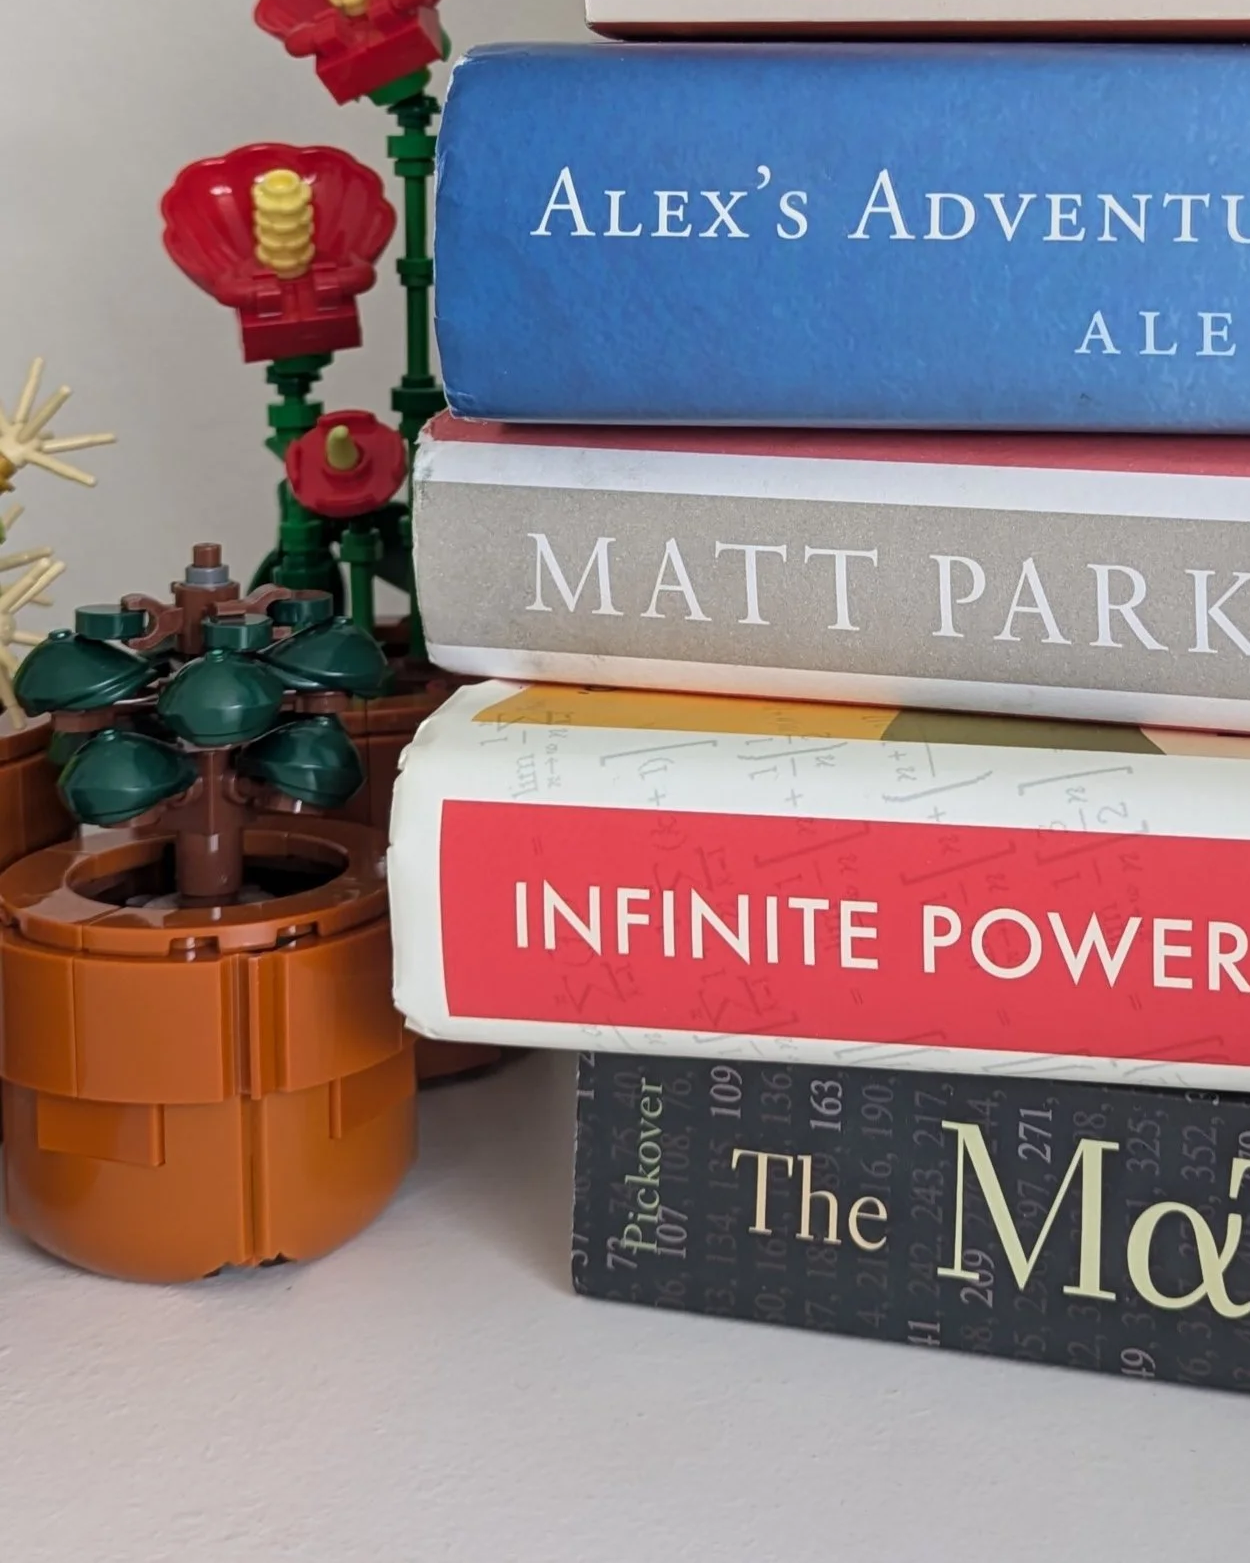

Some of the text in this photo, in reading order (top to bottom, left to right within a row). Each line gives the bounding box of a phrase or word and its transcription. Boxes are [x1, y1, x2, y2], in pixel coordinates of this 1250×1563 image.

[525, 531, 878, 632] MATT
[515, 880, 879, 970] INFINITE
[624, 1077, 663, 1255] Pickover
[731, 1148, 889, 1251] The
